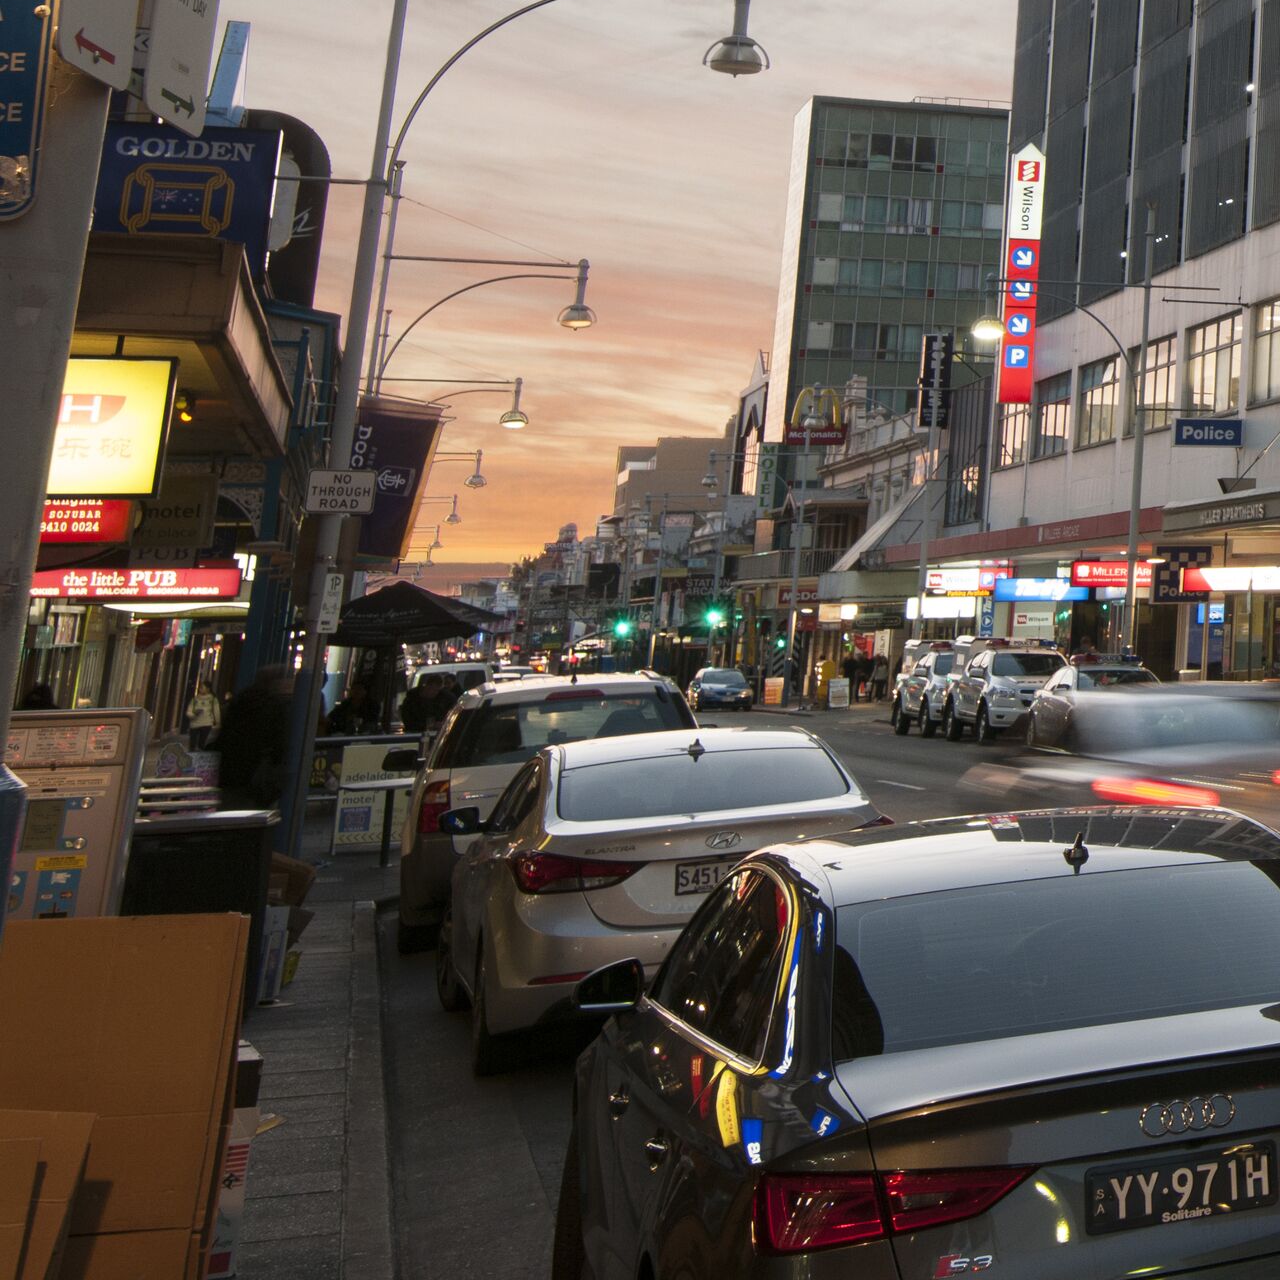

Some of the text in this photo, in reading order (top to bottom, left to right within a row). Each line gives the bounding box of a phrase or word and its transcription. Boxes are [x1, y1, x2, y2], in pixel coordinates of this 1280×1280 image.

[116, 136, 256, 162] GOLDEN
[1021, 185, 1034, 231] Wilson
[1182, 425, 1235, 441] Police
[334, 474, 352, 484] NO
[759, 445, 775, 508] MOTEL
[311, 486, 371, 497] THROUGH
[320, 499, 359, 509] ROAD
[48, 510, 102, 519] SOJUBAR
[72, 521, 99, 533] 0024
[63, 570, 177, 587] the little PUB
[96, 587, 139, 596] BALCONY
[345, 770, 395, 782] adelaide
[342, 794, 376, 804] motel
[584, 845, 637, 855] ELANTRA
[1161, 1205, 1212, 1223] Solitaire
[949, 1254, 993, 1271] S3
